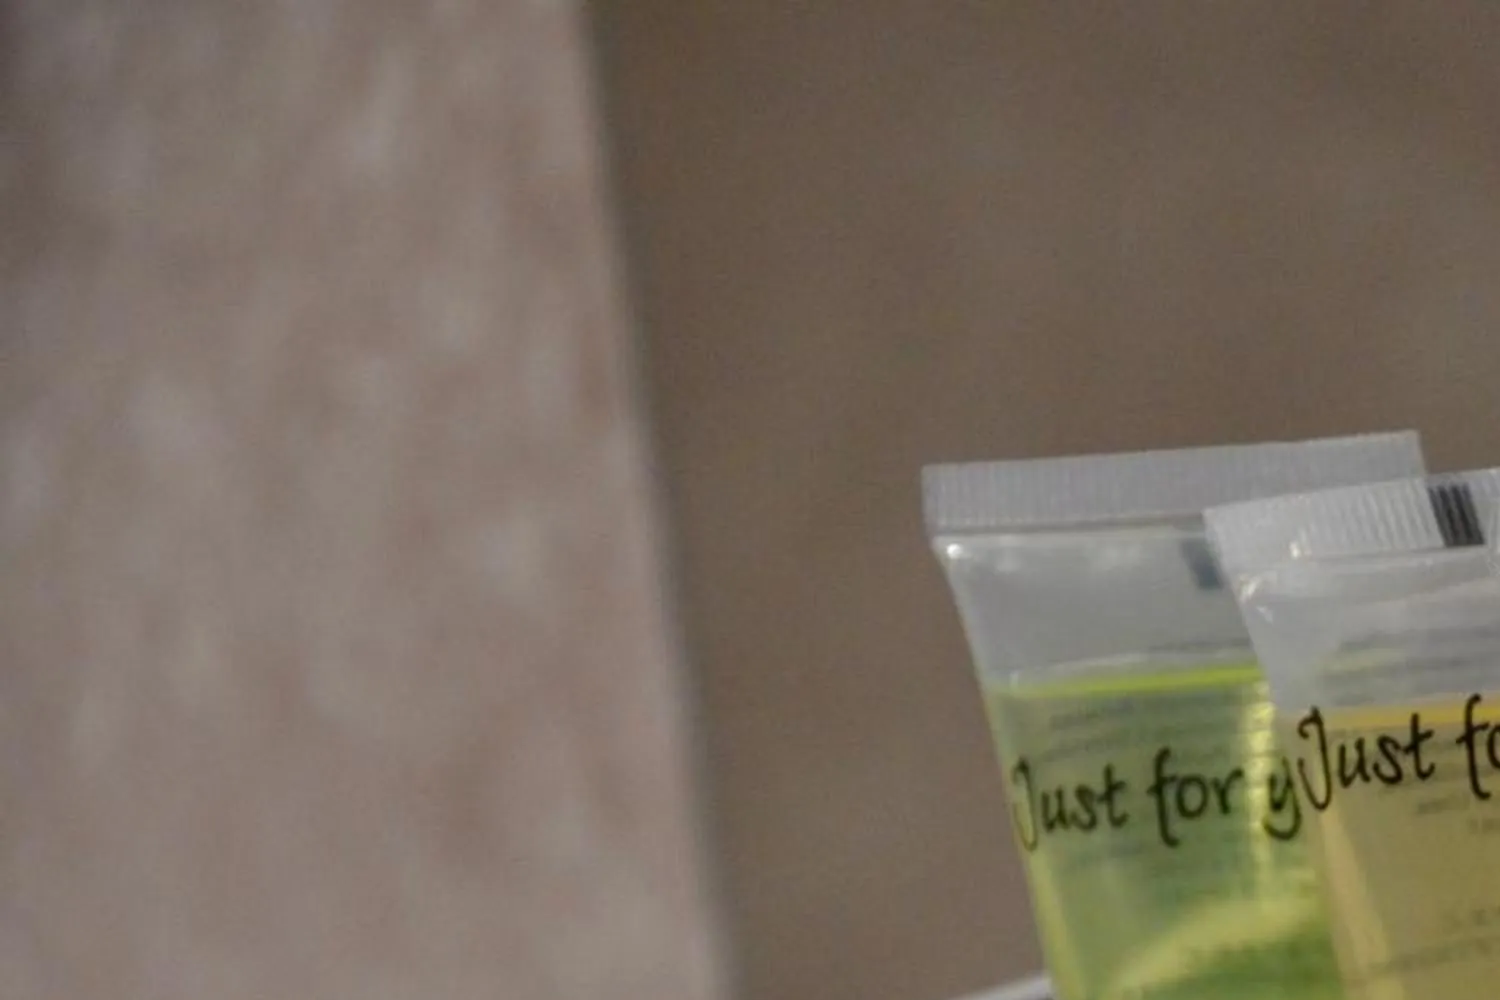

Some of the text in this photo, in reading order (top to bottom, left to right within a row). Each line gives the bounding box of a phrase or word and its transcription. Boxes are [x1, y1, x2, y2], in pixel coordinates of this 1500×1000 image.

[1011, 756, 1130, 852] Just
[1146, 746, 1245, 848] for
[1296, 705, 1436, 811] Just
